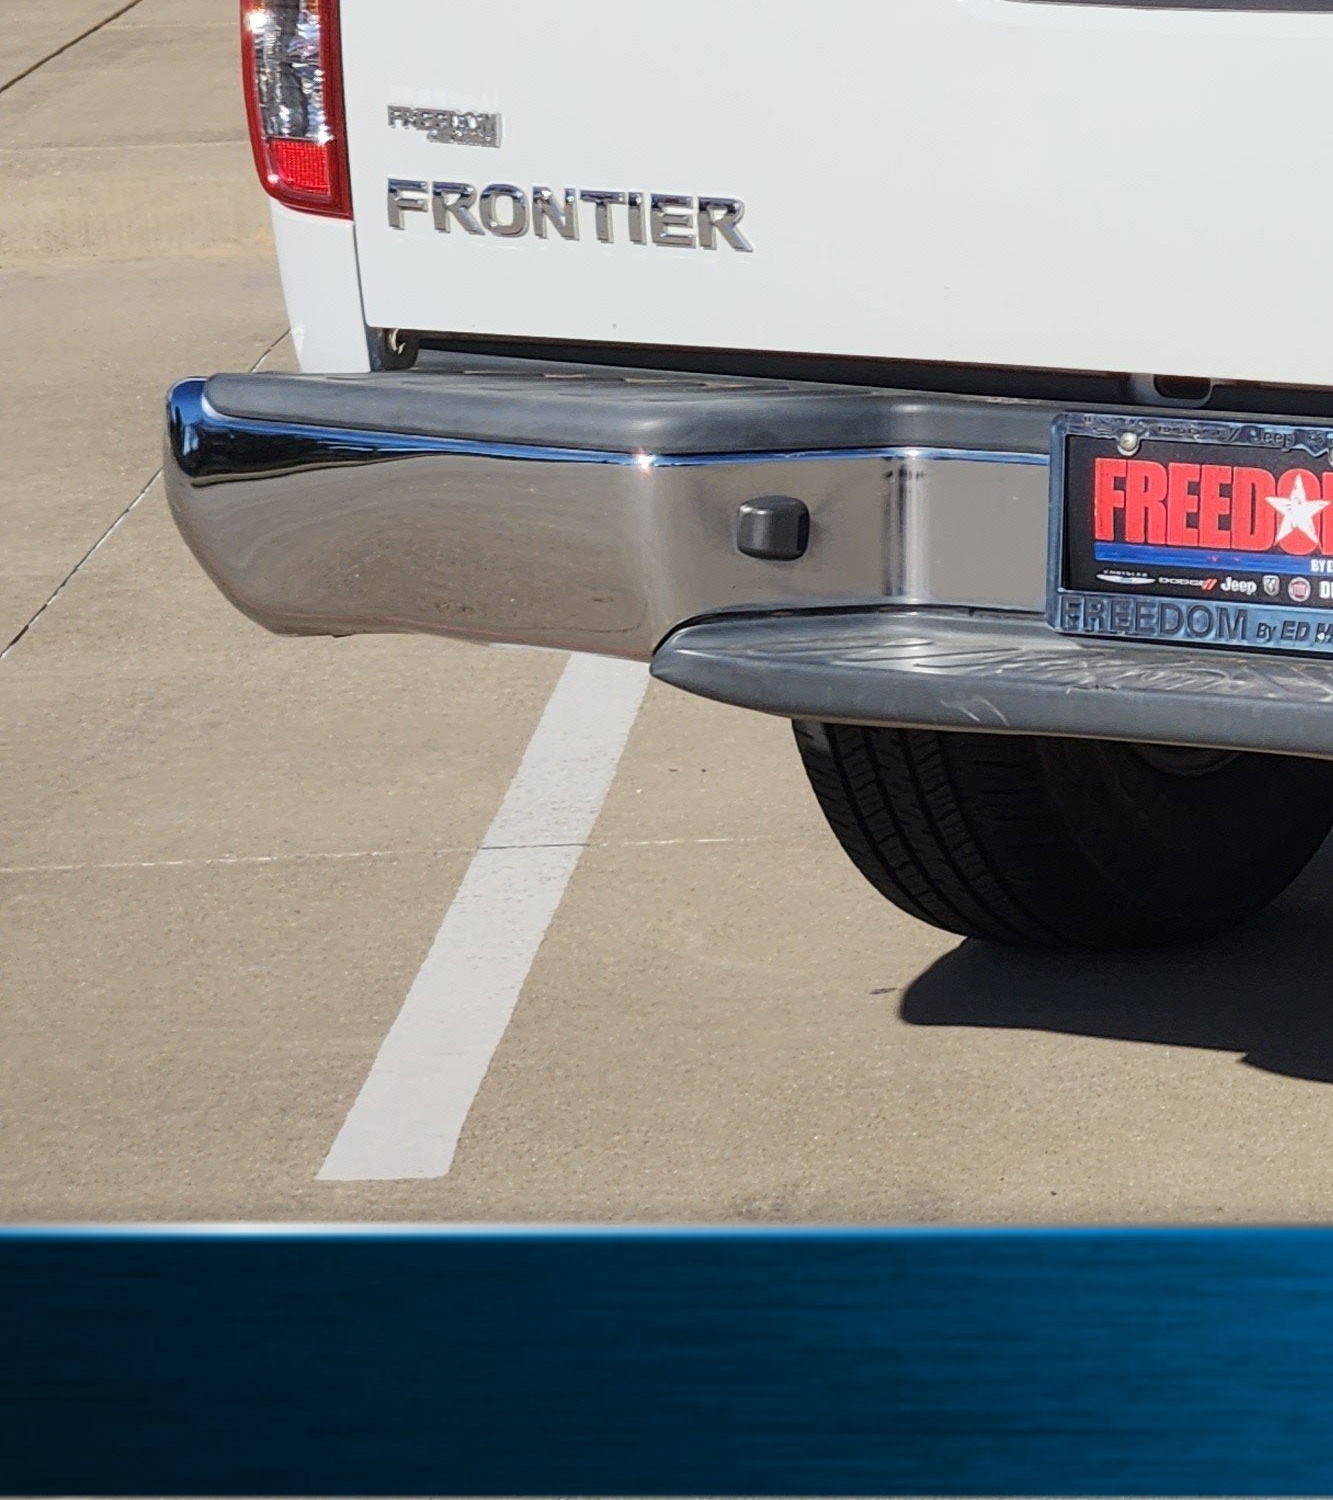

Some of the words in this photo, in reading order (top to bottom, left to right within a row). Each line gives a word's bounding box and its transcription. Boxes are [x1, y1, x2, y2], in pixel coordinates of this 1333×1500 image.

[386, 177, 754, 253] FRONTIER
[1310, 559, 1325, 573] BY
[1220, 576, 1257, 596] Jeep
[1059, 596, 1248, 642] FREEDOM
[1280, 620, 1311, 643] ED
